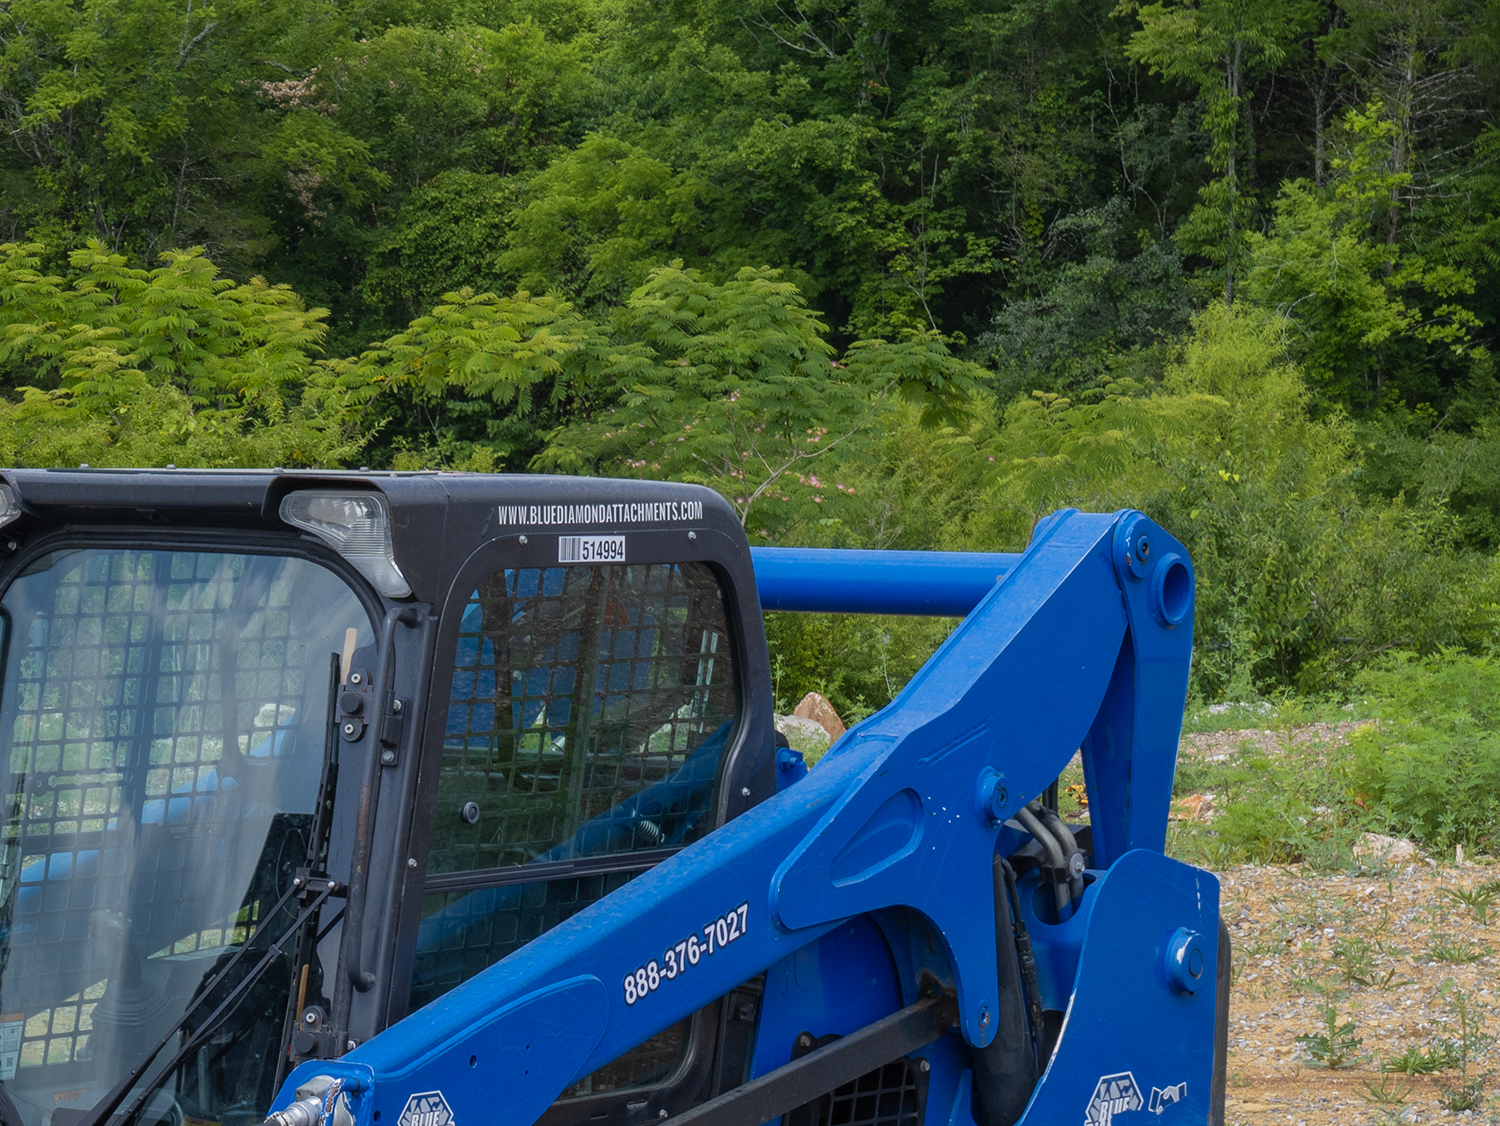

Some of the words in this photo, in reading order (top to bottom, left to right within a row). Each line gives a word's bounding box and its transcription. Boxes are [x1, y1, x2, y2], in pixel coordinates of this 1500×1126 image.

[498, 501, 703, 525] WWW.BLUEDIAMONDATTACHMENTS.COM
[582, 541, 624, 560] 514994
[623, 901, 749, 1006] 888-376-7027
